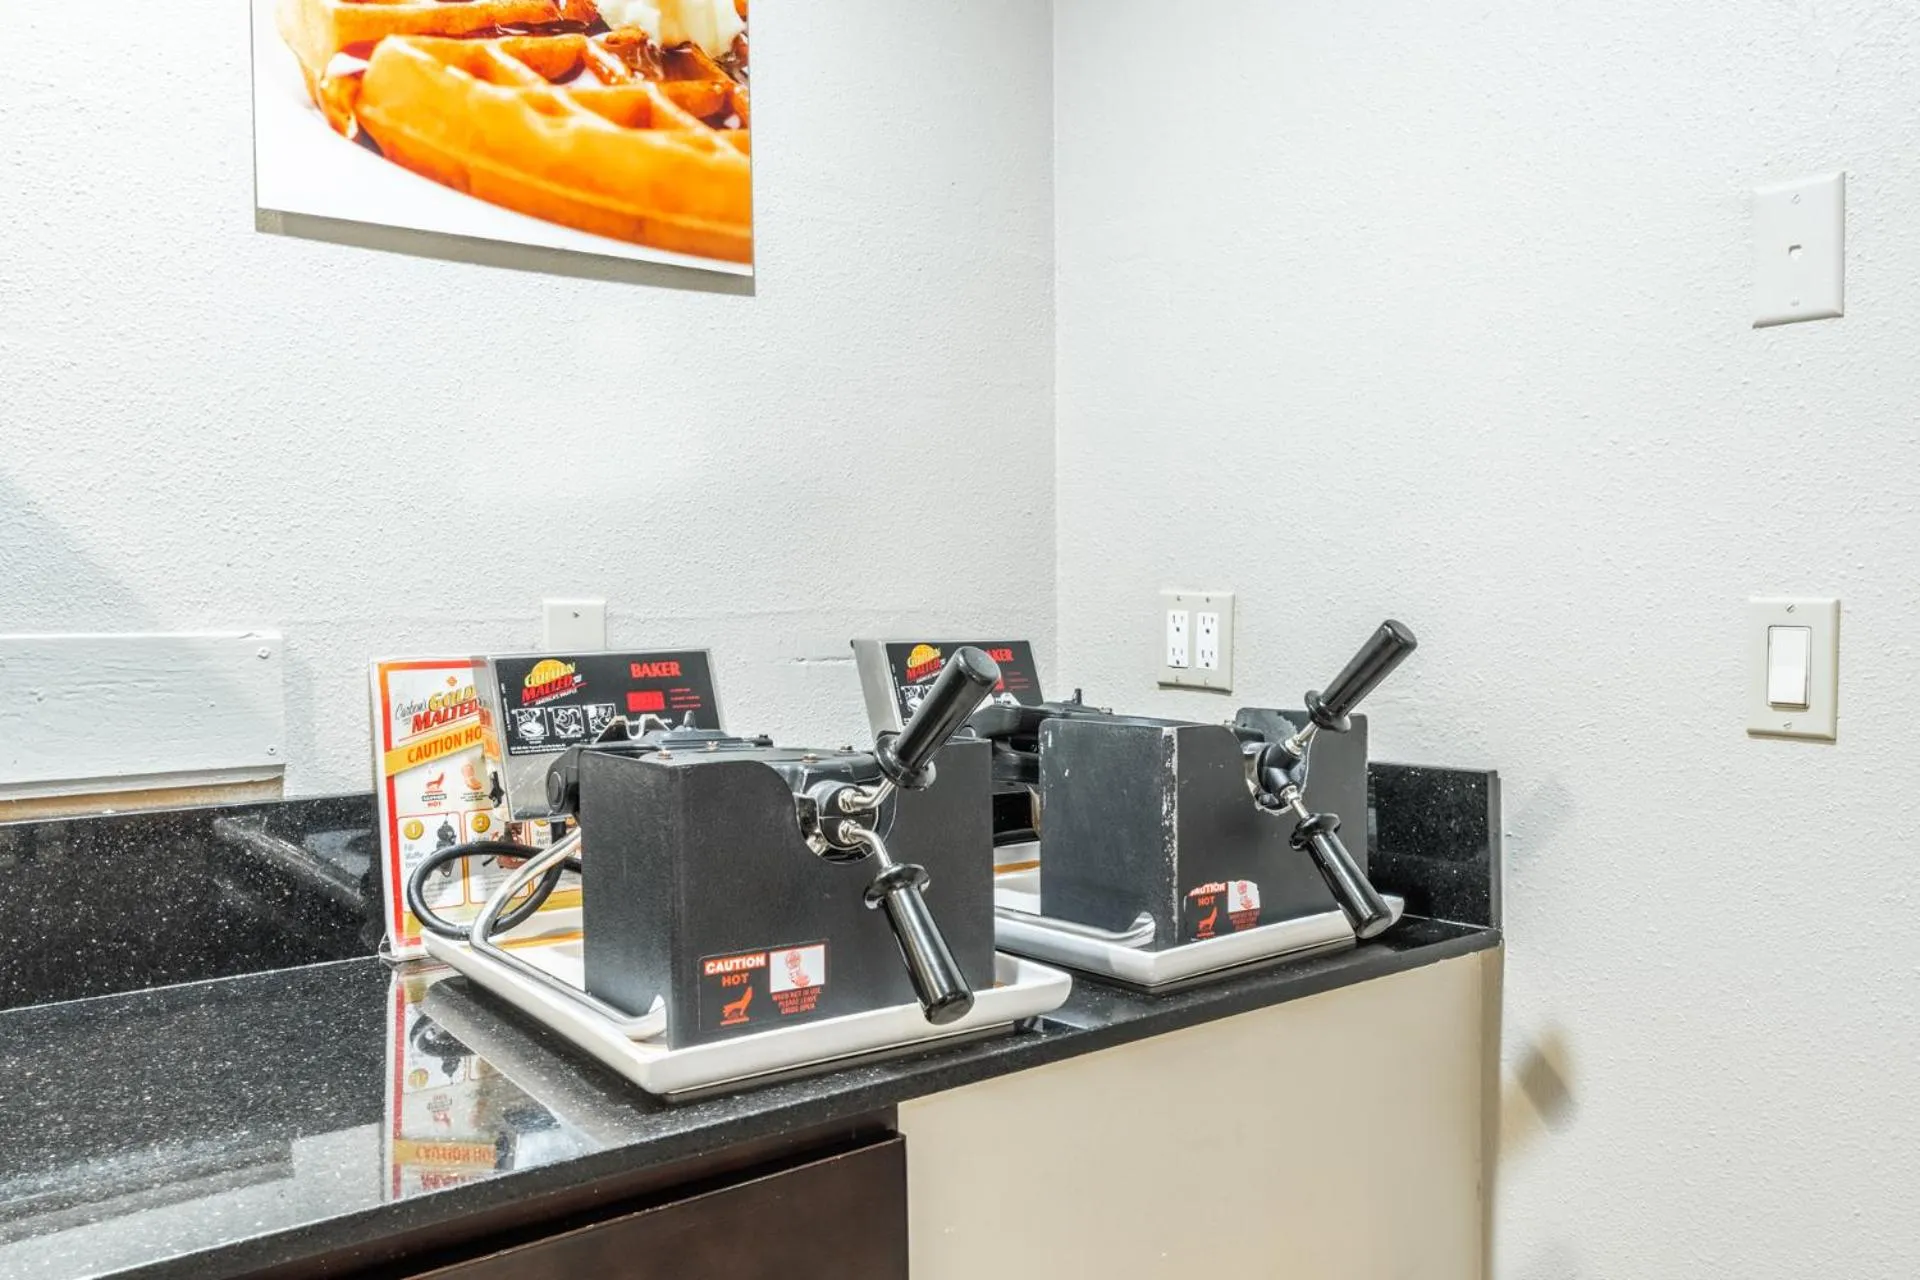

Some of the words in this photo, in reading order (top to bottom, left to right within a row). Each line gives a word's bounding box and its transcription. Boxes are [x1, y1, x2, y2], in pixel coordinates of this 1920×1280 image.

[630, 661, 682, 678] BAKER
[428, 685, 477, 713] GOLD
[522, 674, 574, 705] MALTED
[412, 699, 480, 733] MALTED
[407, 733, 462, 763] CAUTION
[465, 725, 482, 743] HO
[1198, 895, 1215, 906] HOT
[705, 954, 765, 974] CAUTION
[722, 974, 749, 987] HOT
